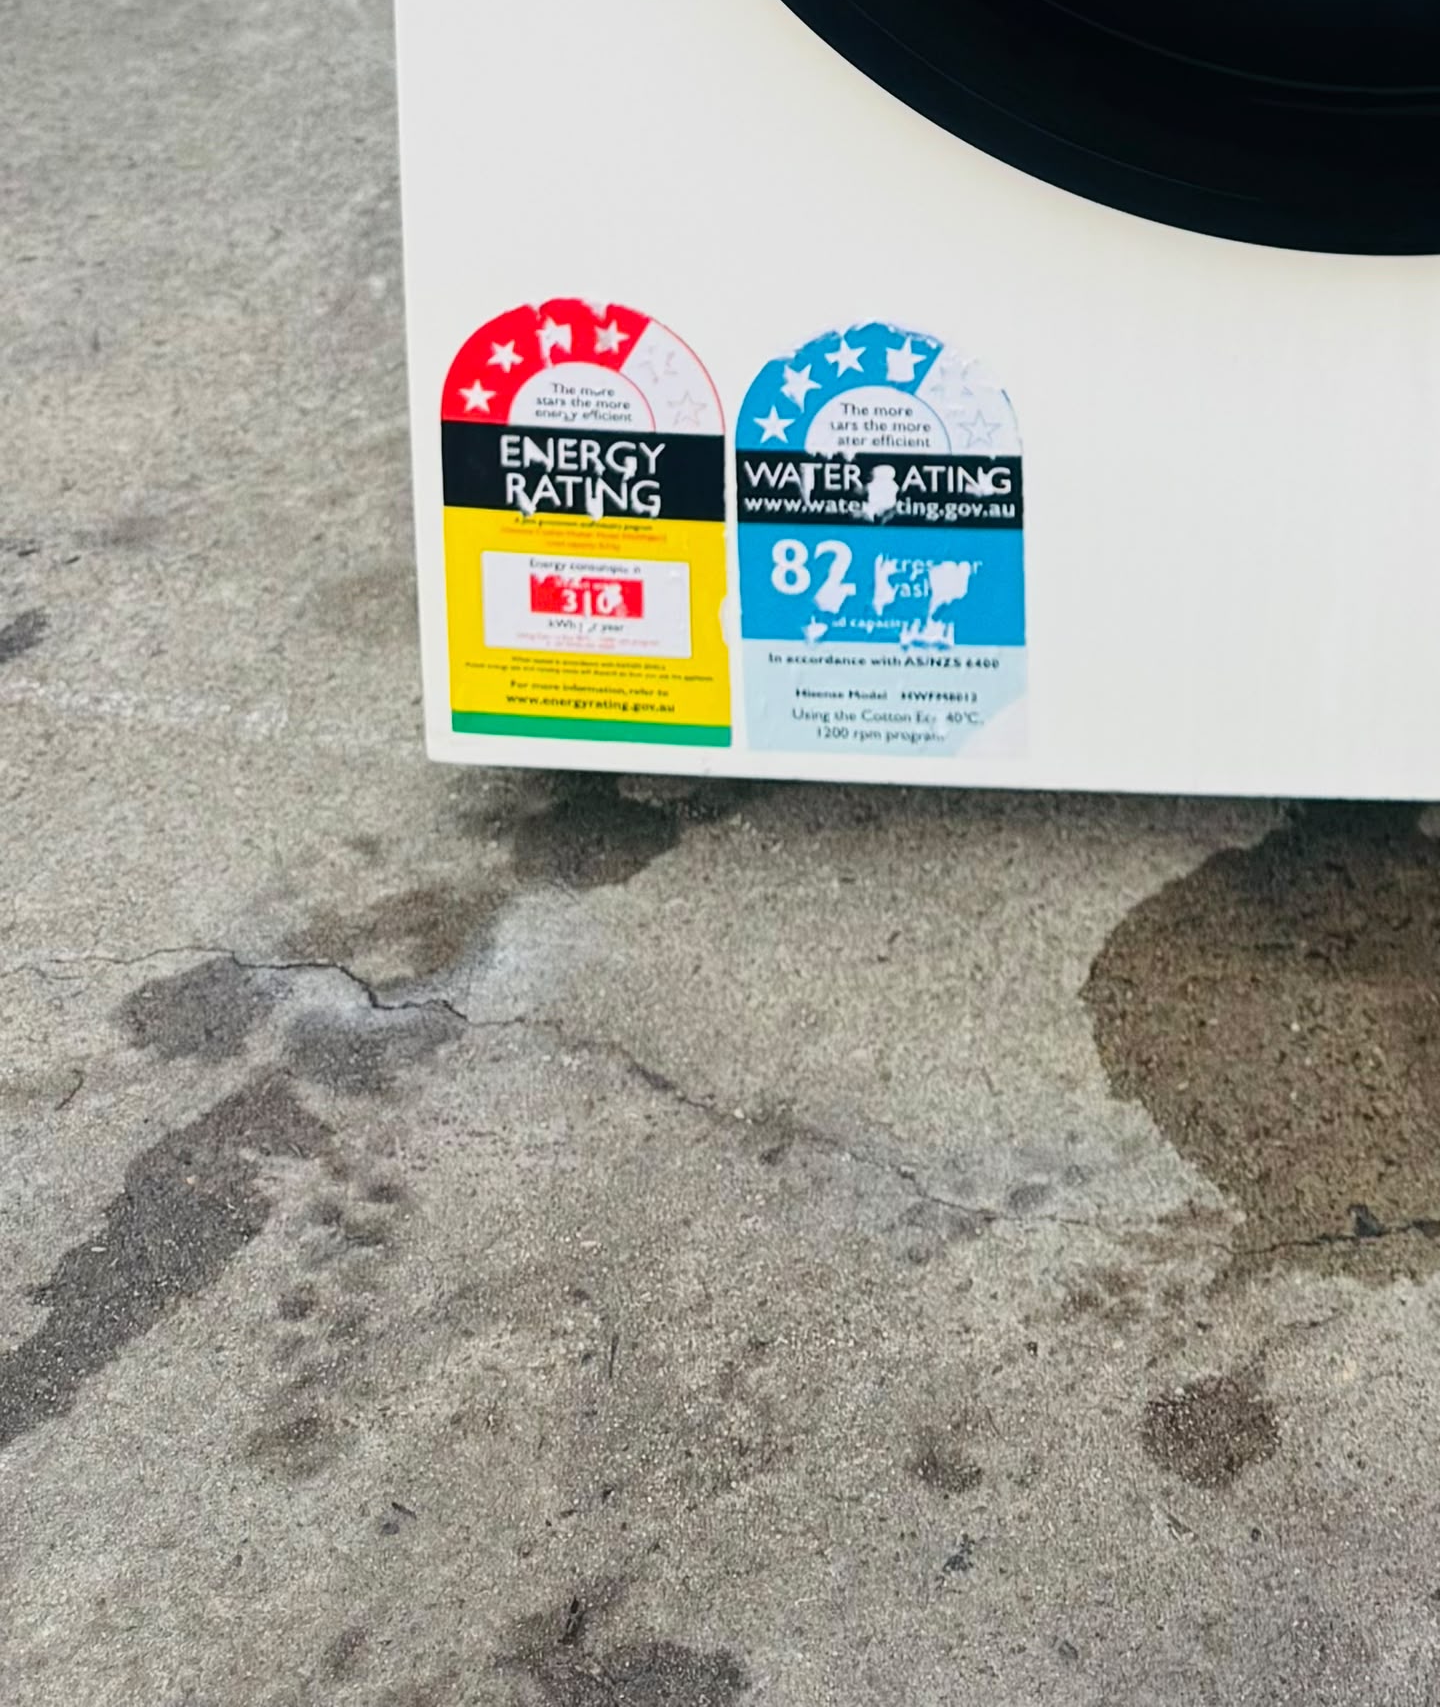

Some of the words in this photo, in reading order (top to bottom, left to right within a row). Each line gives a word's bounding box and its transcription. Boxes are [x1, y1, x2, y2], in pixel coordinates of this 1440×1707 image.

[552, 383, 576, 395] The
[536, 397, 566, 406] stars
[571, 395, 591, 407] the
[596, 401, 630, 409] more
[840, 403, 868, 415] The
[874, 406, 913, 416] more
[864, 420, 887, 431] the
[893, 423, 931, 432] more
[838, 435, 865, 445] ater
[872, 434, 930, 447] efficient
[500, 434, 666, 477] ENERGY
[745, 460, 862, 492] WATER
[870, 465, 1012, 494] ATING
[506, 472, 661, 518] RATING
[771, 538, 856, 605] 82
[769, 653, 783, 663] In
[786, 654, 866, 666] accordance
[871, 655, 901, 667] with
[792, 708, 830, 722] Using
[835, 710, 856, 721] the
[861, 710, 911, 722] Cotton
[817, 727, 849, 738] 1200
[854, 728, 882, 741] rpm
